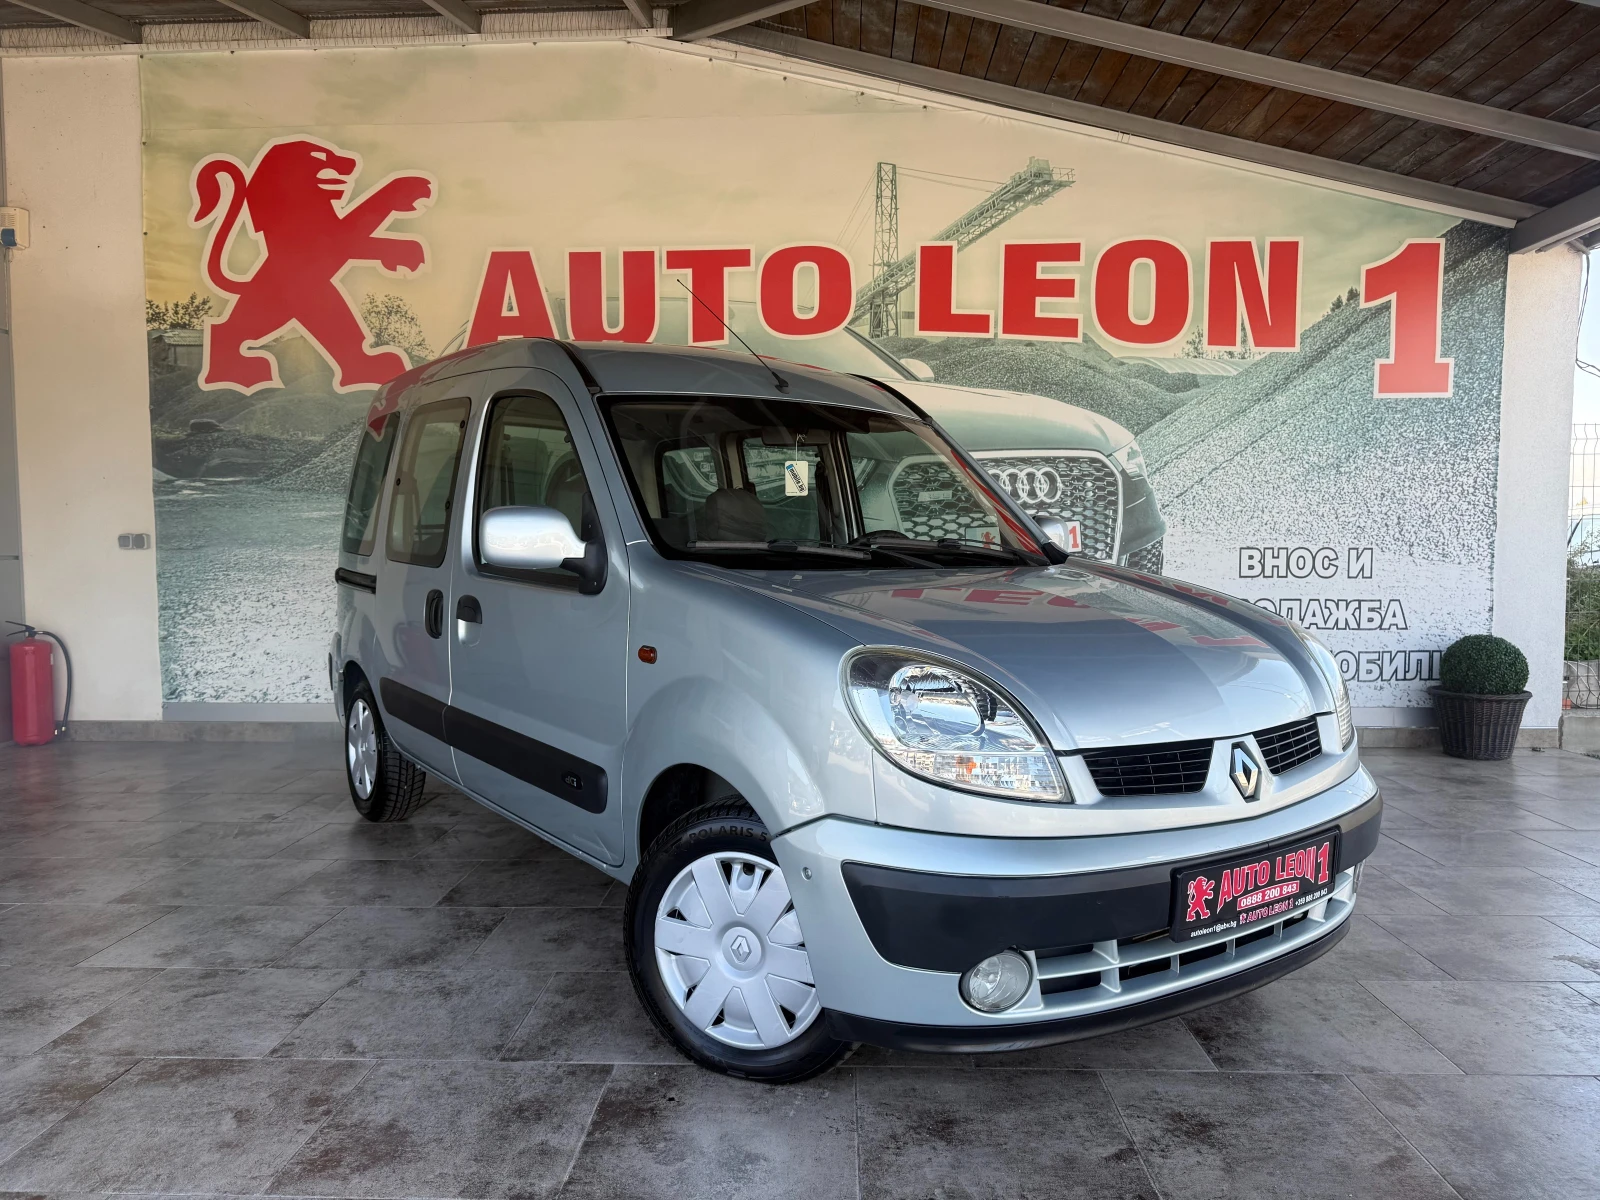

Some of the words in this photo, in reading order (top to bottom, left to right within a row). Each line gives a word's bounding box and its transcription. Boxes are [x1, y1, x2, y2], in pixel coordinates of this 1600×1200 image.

[462, 242, 856, 346] AUTO
[915, 237, 1301, 352] LEON
[1361, 238, 1453, 398] 1
[1239, 547, 1338, 578] ВНОС
[1347, 547, 1373, 579] И
[689, 825, 754, 843] POLARIS
[1217, 861, 1270, 914] AUTO
[1275, 846, 1317, 883] LEON
[1318, 842, 1330, 885] 1
[1241, 892, 1262, 907] 0888
[1265, 887, 1280, 900] 200
[1282, 883, 1297, 894] 843
[1247, 906, 1268, 923] AUTO
[1269, 901, 1288, 916] LEON
